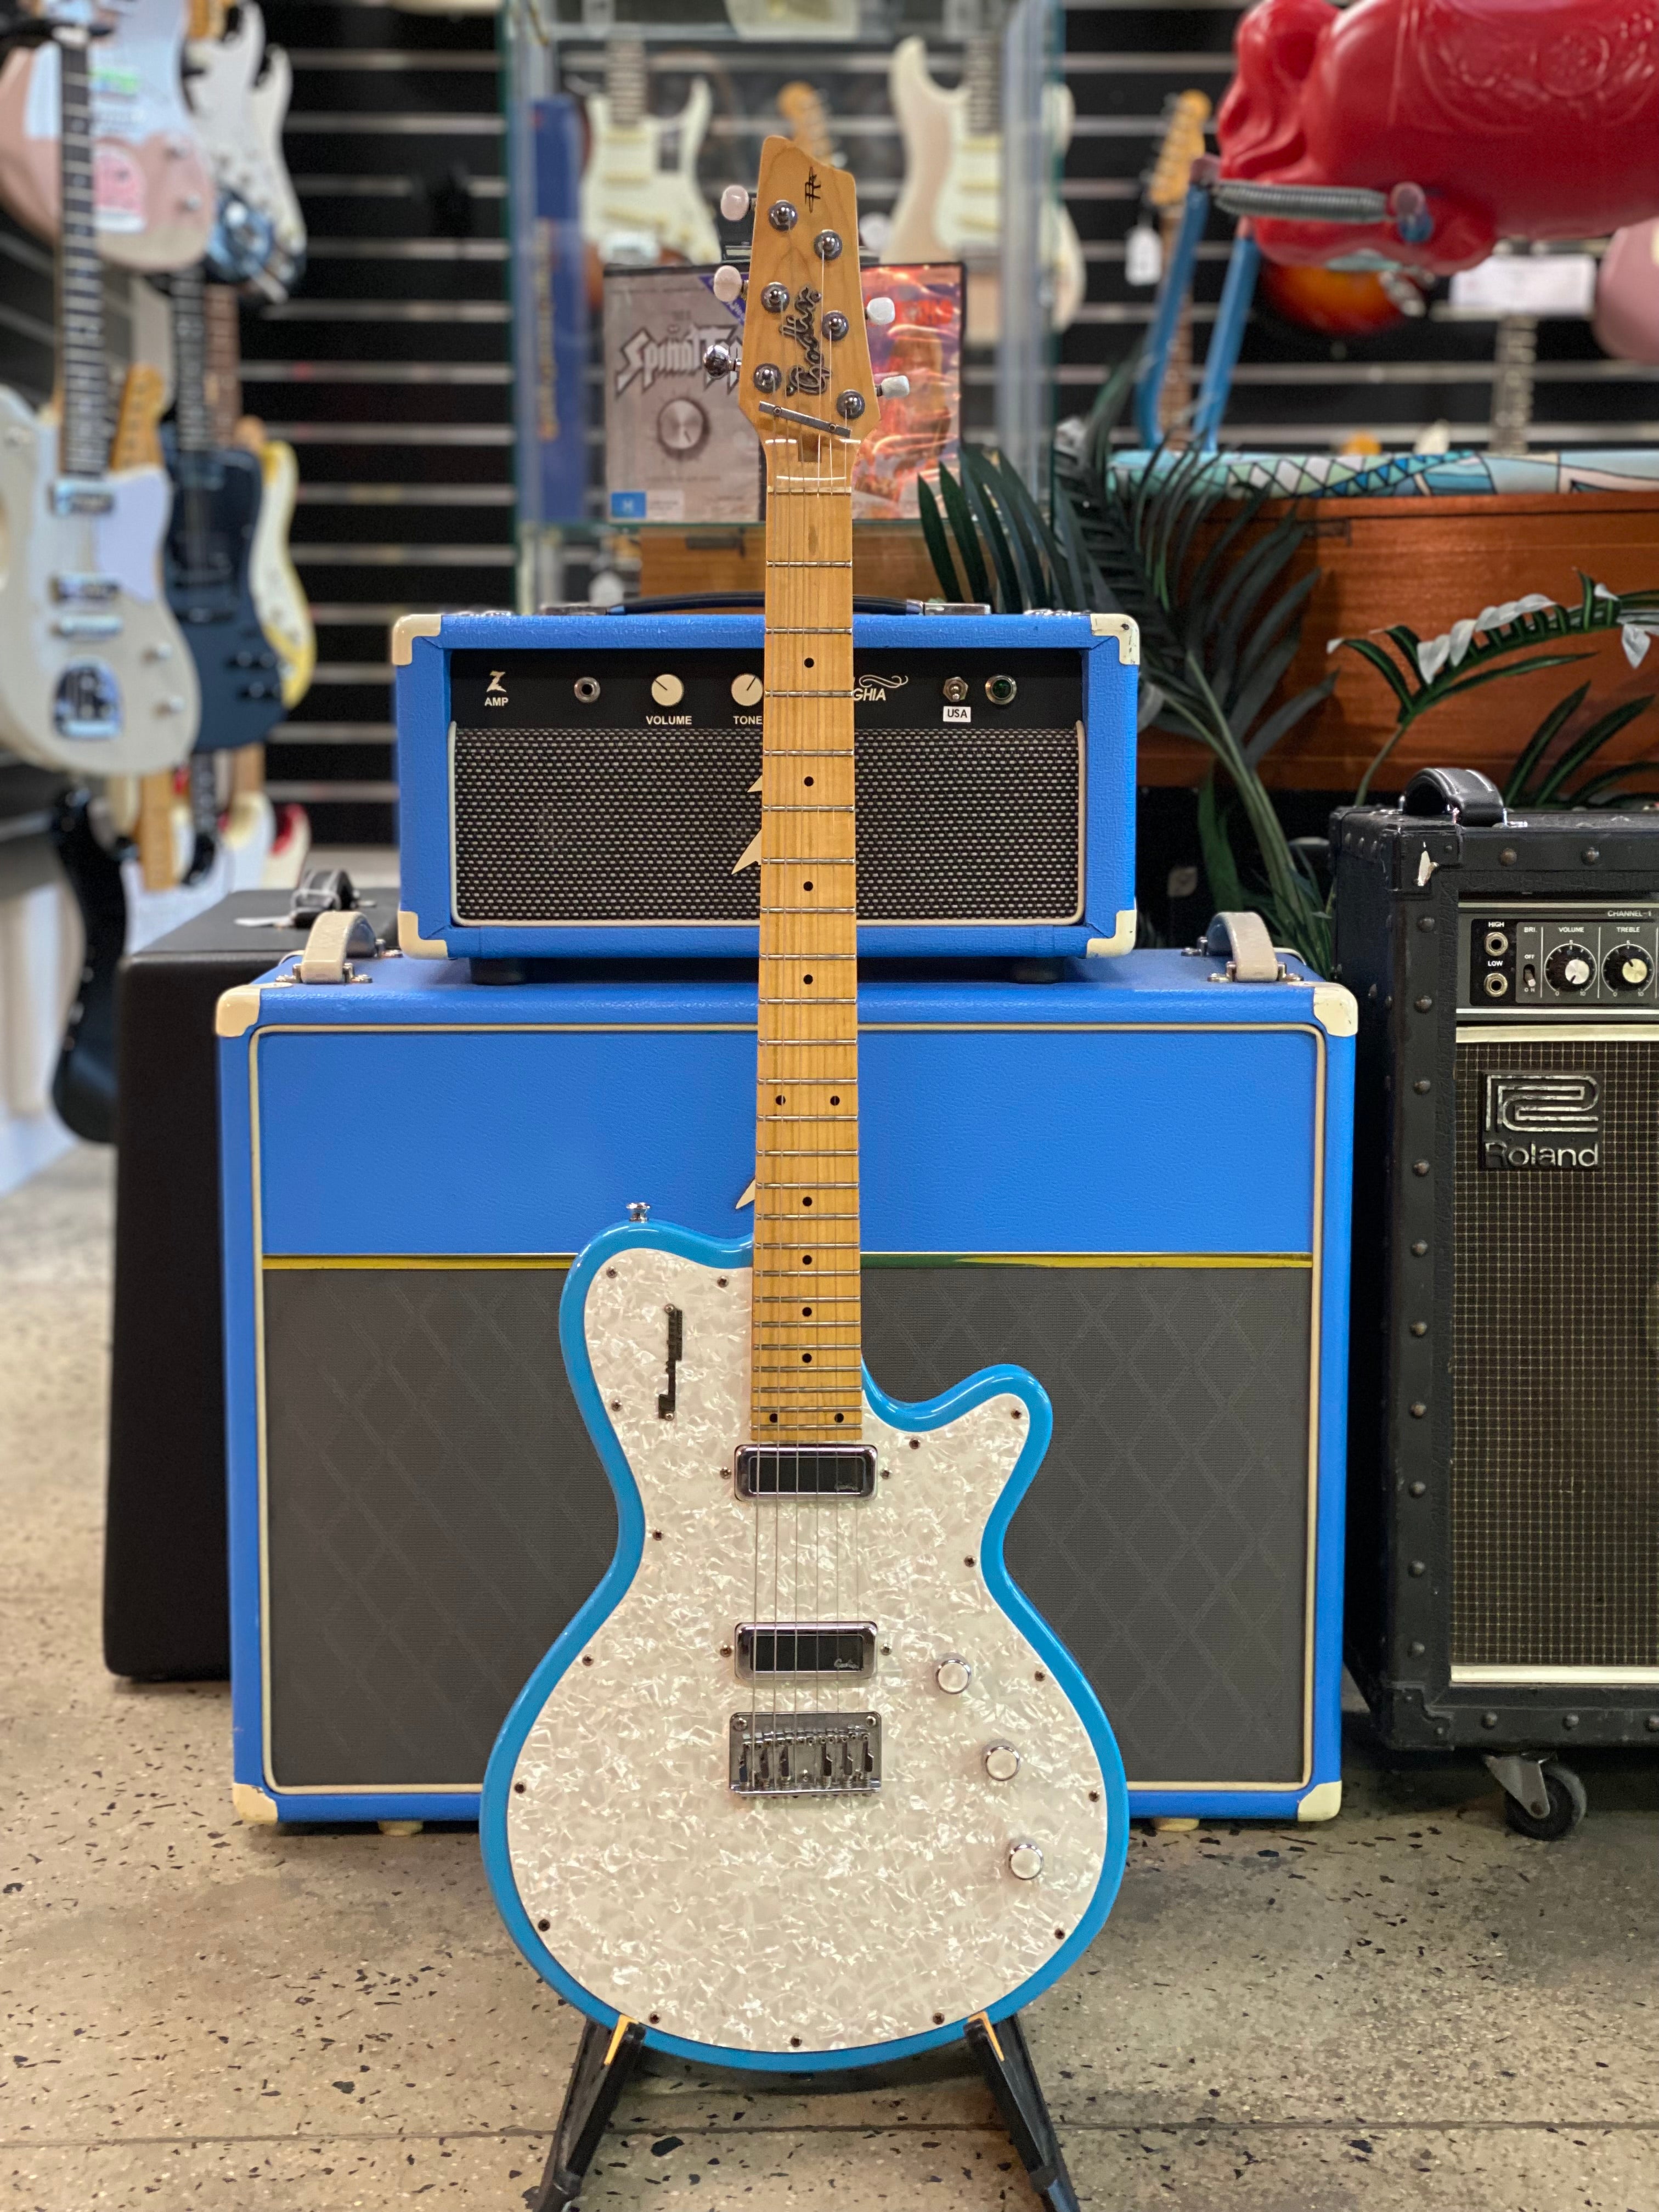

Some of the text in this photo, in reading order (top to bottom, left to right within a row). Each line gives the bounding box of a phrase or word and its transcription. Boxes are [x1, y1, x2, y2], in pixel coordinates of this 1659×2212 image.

[853, 687, 887, 702] GHIA
[484, 697, 509, 707] AMP
[947, 708, 968, 718] USA
[646, 715, 692, 725] VOLUME
[733, 715, 763, 725] TONE
[1485, 1139, 1599, 1167] Roland
